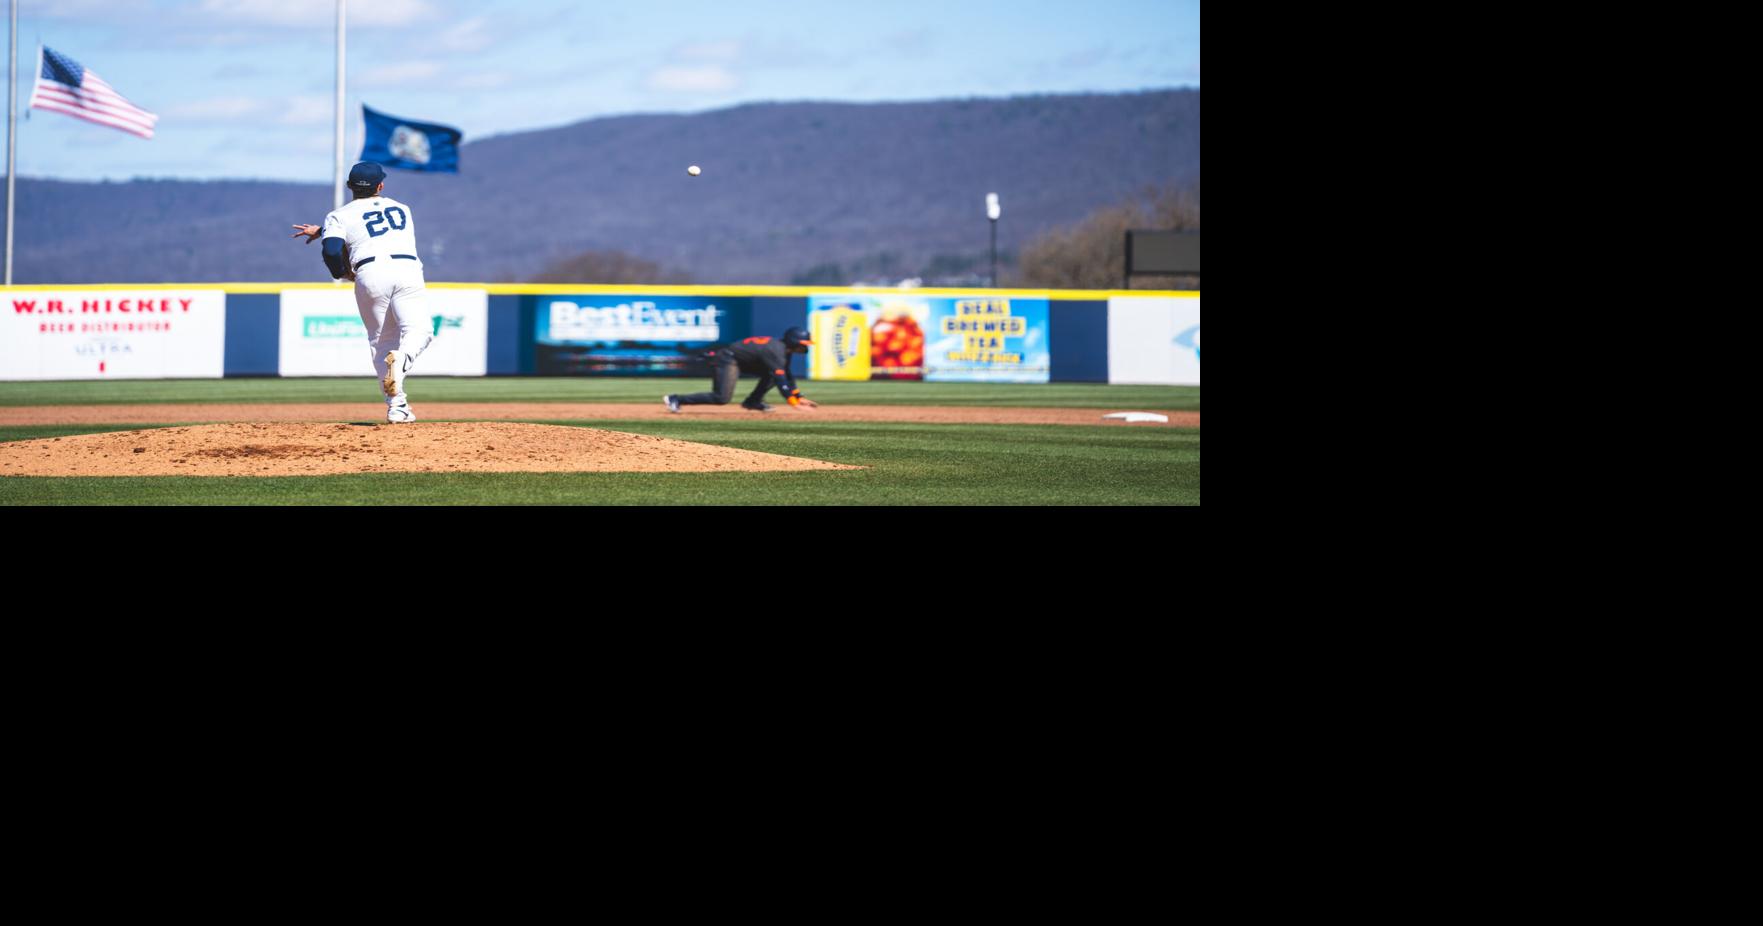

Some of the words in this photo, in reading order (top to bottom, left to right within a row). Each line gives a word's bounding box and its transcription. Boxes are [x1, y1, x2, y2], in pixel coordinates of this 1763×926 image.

[362, 206, 407, 238] 20
[12, 299, 74, 313] W.R.
[81, 298, 193, 313] HICKEY
[38, 322, 75, 333] BEER
[946, 320, 1020, 332] BREWED
